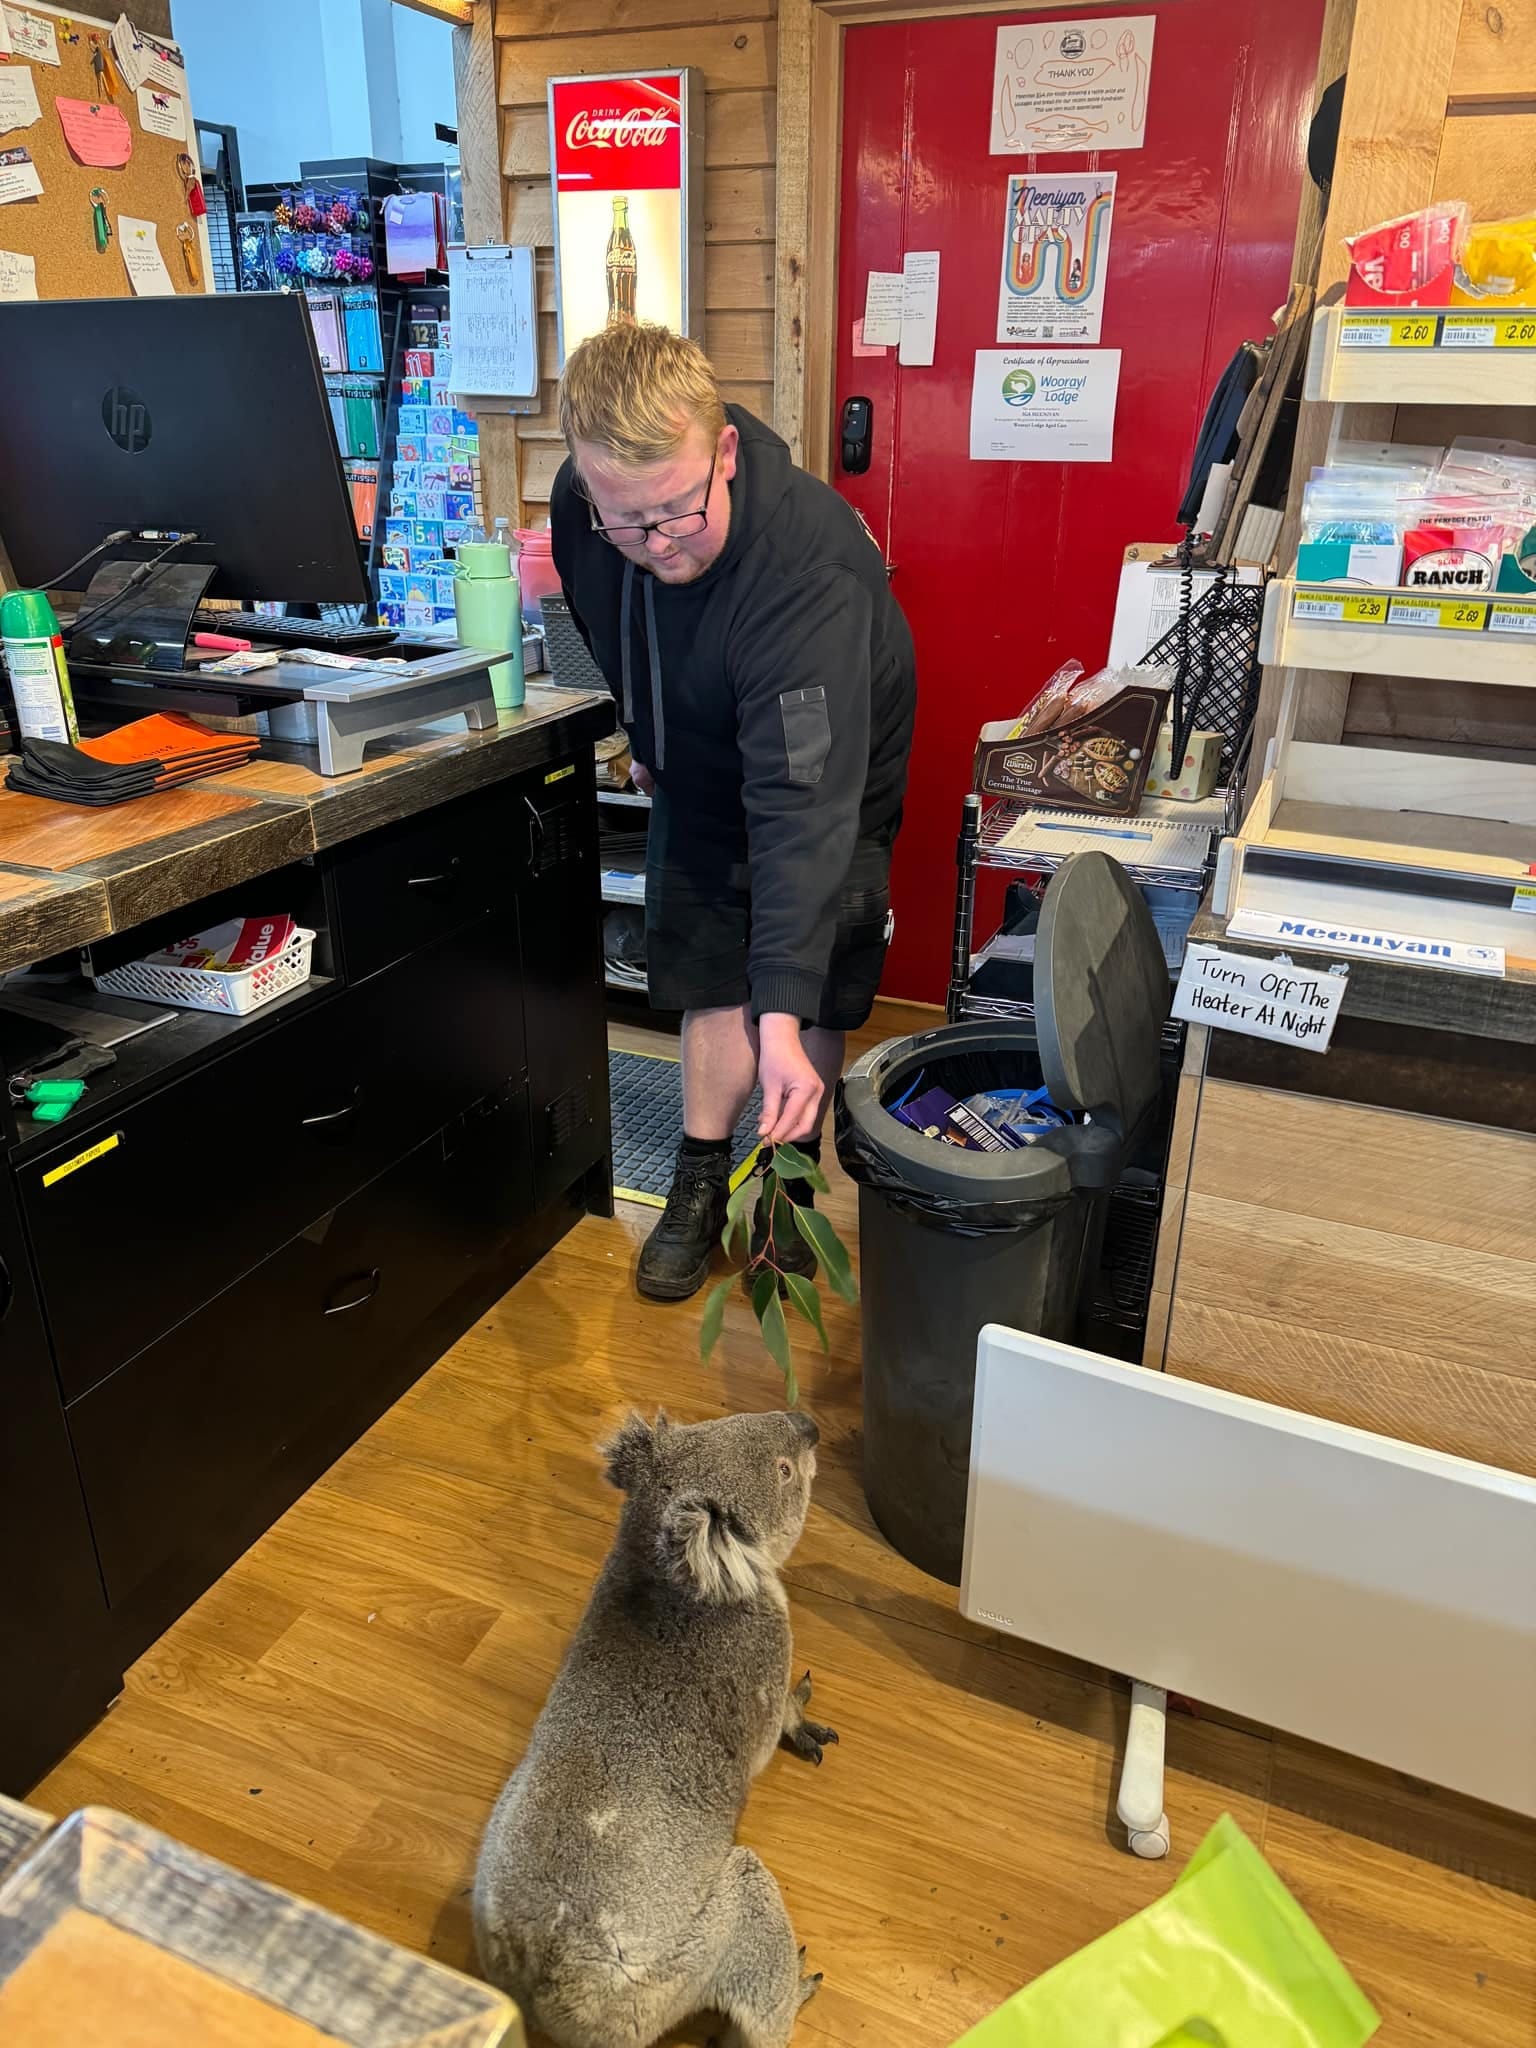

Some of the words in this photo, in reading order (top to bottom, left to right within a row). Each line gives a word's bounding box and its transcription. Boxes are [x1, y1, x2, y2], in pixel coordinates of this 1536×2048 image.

[1048, 69, 1076, 78] THANK
[1077, 68, 1095, 77] YOU
[592, 108, 621, 116] DRINK
[566, 106, 672, 150] CocaCola
[1012, 186, 1086, 212] Meeniyan
[1012, 224, 1068, 244] GRAS
[413, 326, 429, 342] 12
[1400, 326, 1428, 340] $2.60
[1504, 324, 1536, 339] $2.60
[406, 353, 423, 377] 11
[1002, 357, 1035, 366] Certificate
[1037, 357, 1044, 366] of
[1046, 356, 1090, 366] Appreciation
[1040, 376, 1087, 390] Woorayl
[346, 390, 371, 398] TISSUE
[1045, 391, 1079, 405] Lodge
[112, 387, 146, 451] hp
[456, 472, 469, 482] 10
[392, 493, 400, 504] 6
[403, 524, 409, 532] 5
[416, 526, 425, 543] 5
[429, 552, 435, 560] 4
[425, 579, 431, 590] 3
[1413, 570, 1484, 586] RANCH
[382, 580, 390, 592] 3
[424, 607, 431, 618] 2
[1358, 603, 1380, 616] $2.39
[1454, 610, 1479, 622] $2.69
[988, 780, 1015, 790] German
[1016, 785, 1042, 794] Sausage
[1001, 775, 1015, 783] The
[1016, 778, 1032, 786] True
[1278, 920, 1452, 957] Meeniyan
[1196, 958, 1246, 988] Turn
[1260, 974, 1290, 1000] Off
[1298, 982, 1330, 1010] The
[1191, 987, 1253, 1020] Heater
[1254, 1006, 1276, 1024] At
[1280, 1010, 1327, 1038] Night
